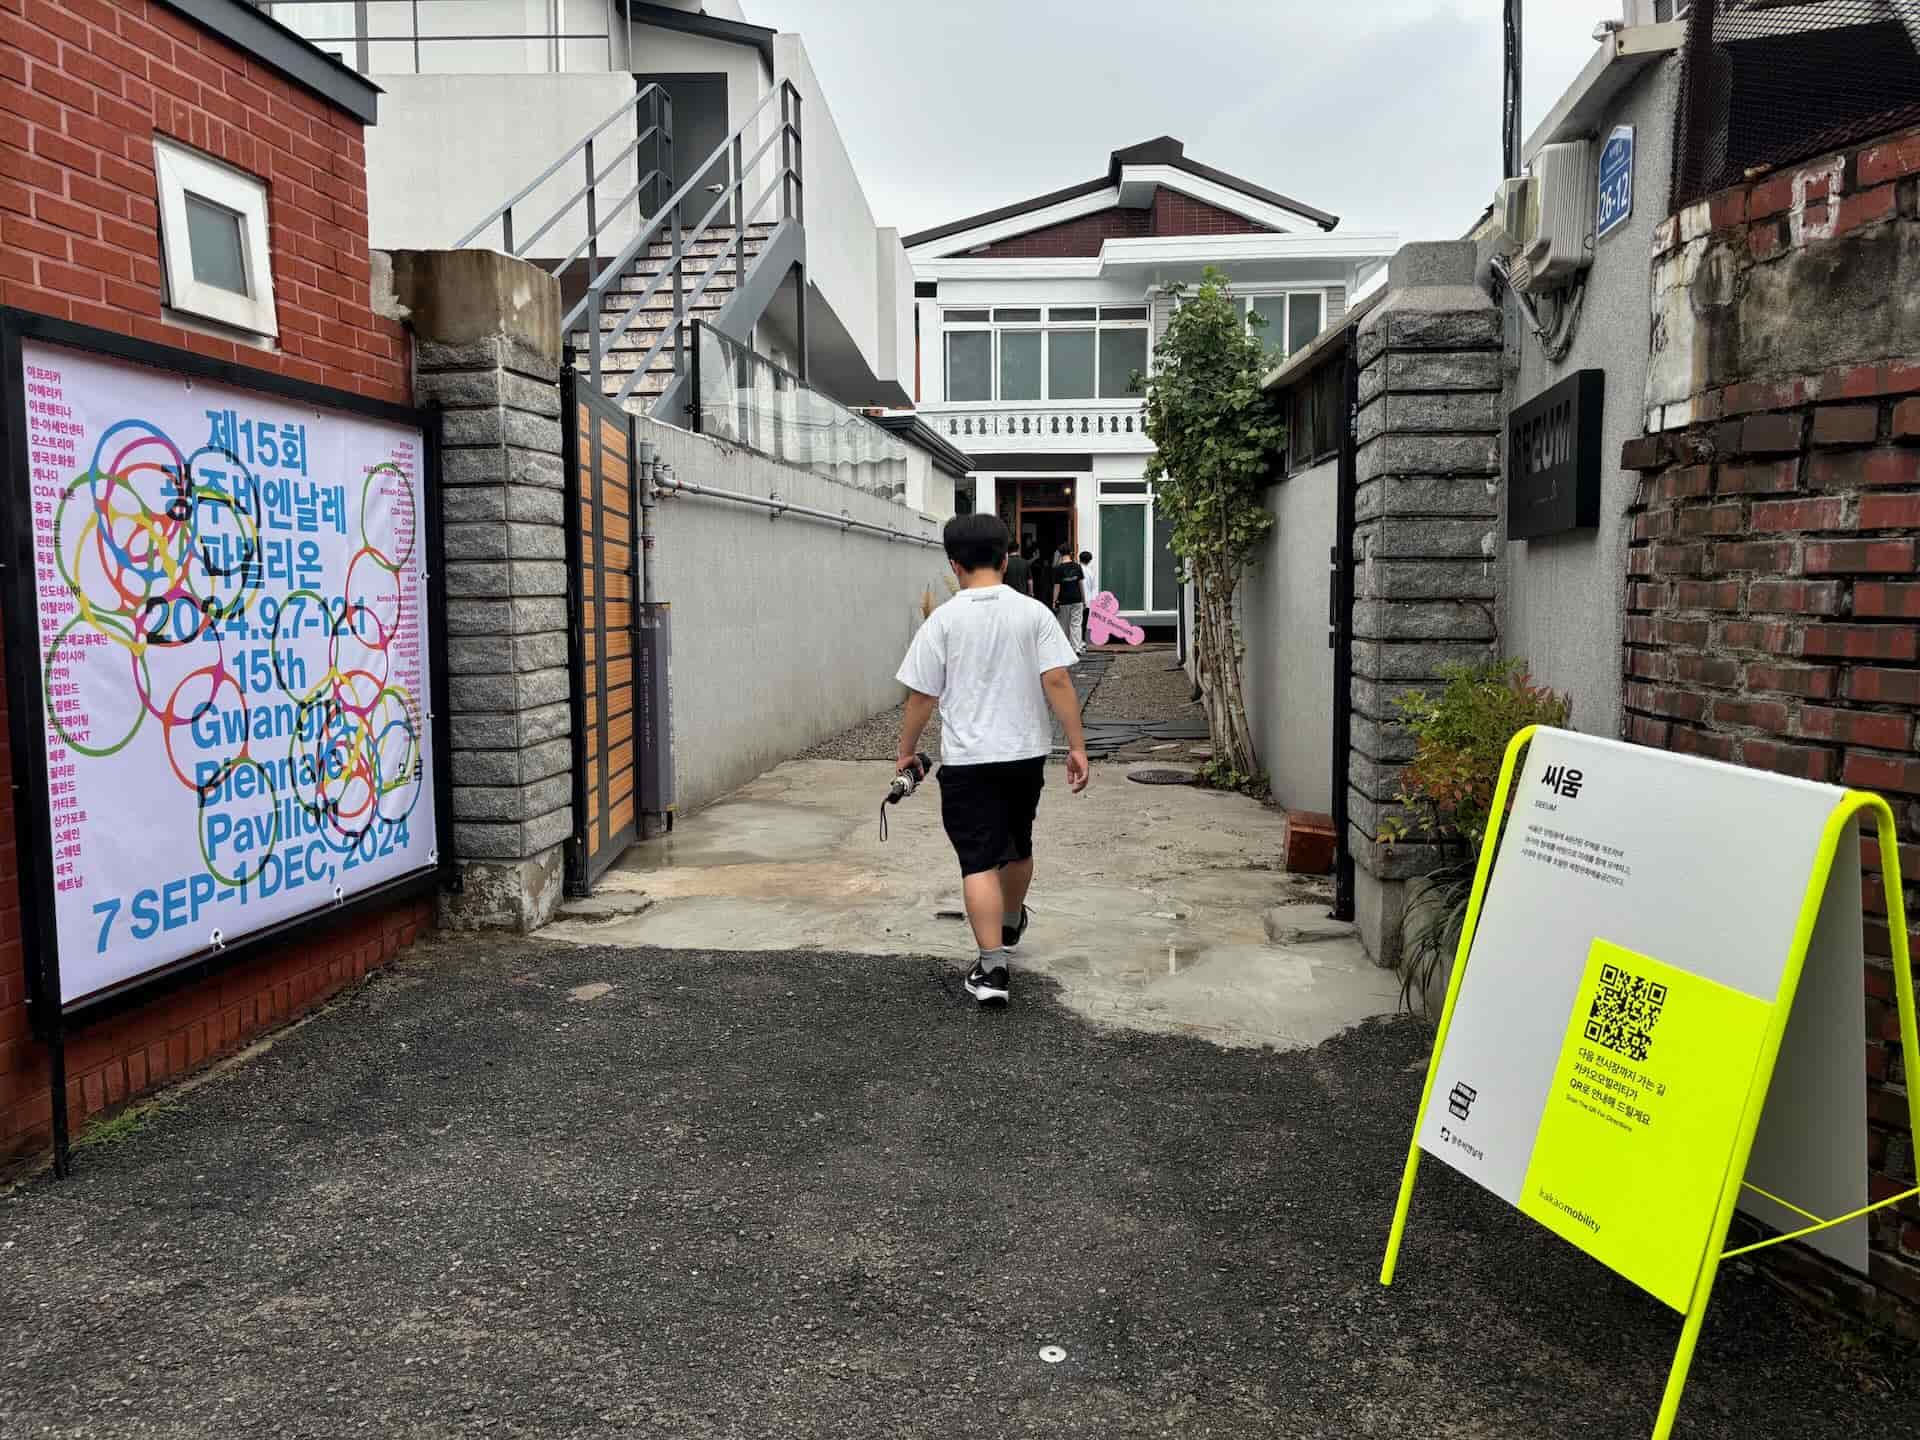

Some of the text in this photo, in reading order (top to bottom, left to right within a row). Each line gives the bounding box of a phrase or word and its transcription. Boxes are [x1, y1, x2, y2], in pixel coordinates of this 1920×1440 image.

[1600, 171, 1628, 226] 26-12
[32, 434, 75, 451] 오스트리아
[205, 410, 308, 477] 제15회
[160, 462, 346, 535] 광주비엔날레
[200, 533, 323, 590] 파빌리온
[232, 648, 306, 693] 15th
[192, 690, 343, 749] Gwangju
[1541, 765, 1583, 799] 씨움
[93, 898, 121, 953] 7
[130, 861, 248, 940] SEP-1
[1573, 1061, 1639, 1102] 카카오모빌리티가
[1578, 1047, 1666, 1097] 다음 전시장까지 가는 길
[1569, 1078, 1651, 1126] QR로 안내해 드릴게요
[1538, 1187, 1601, 1235] kakaomobility
